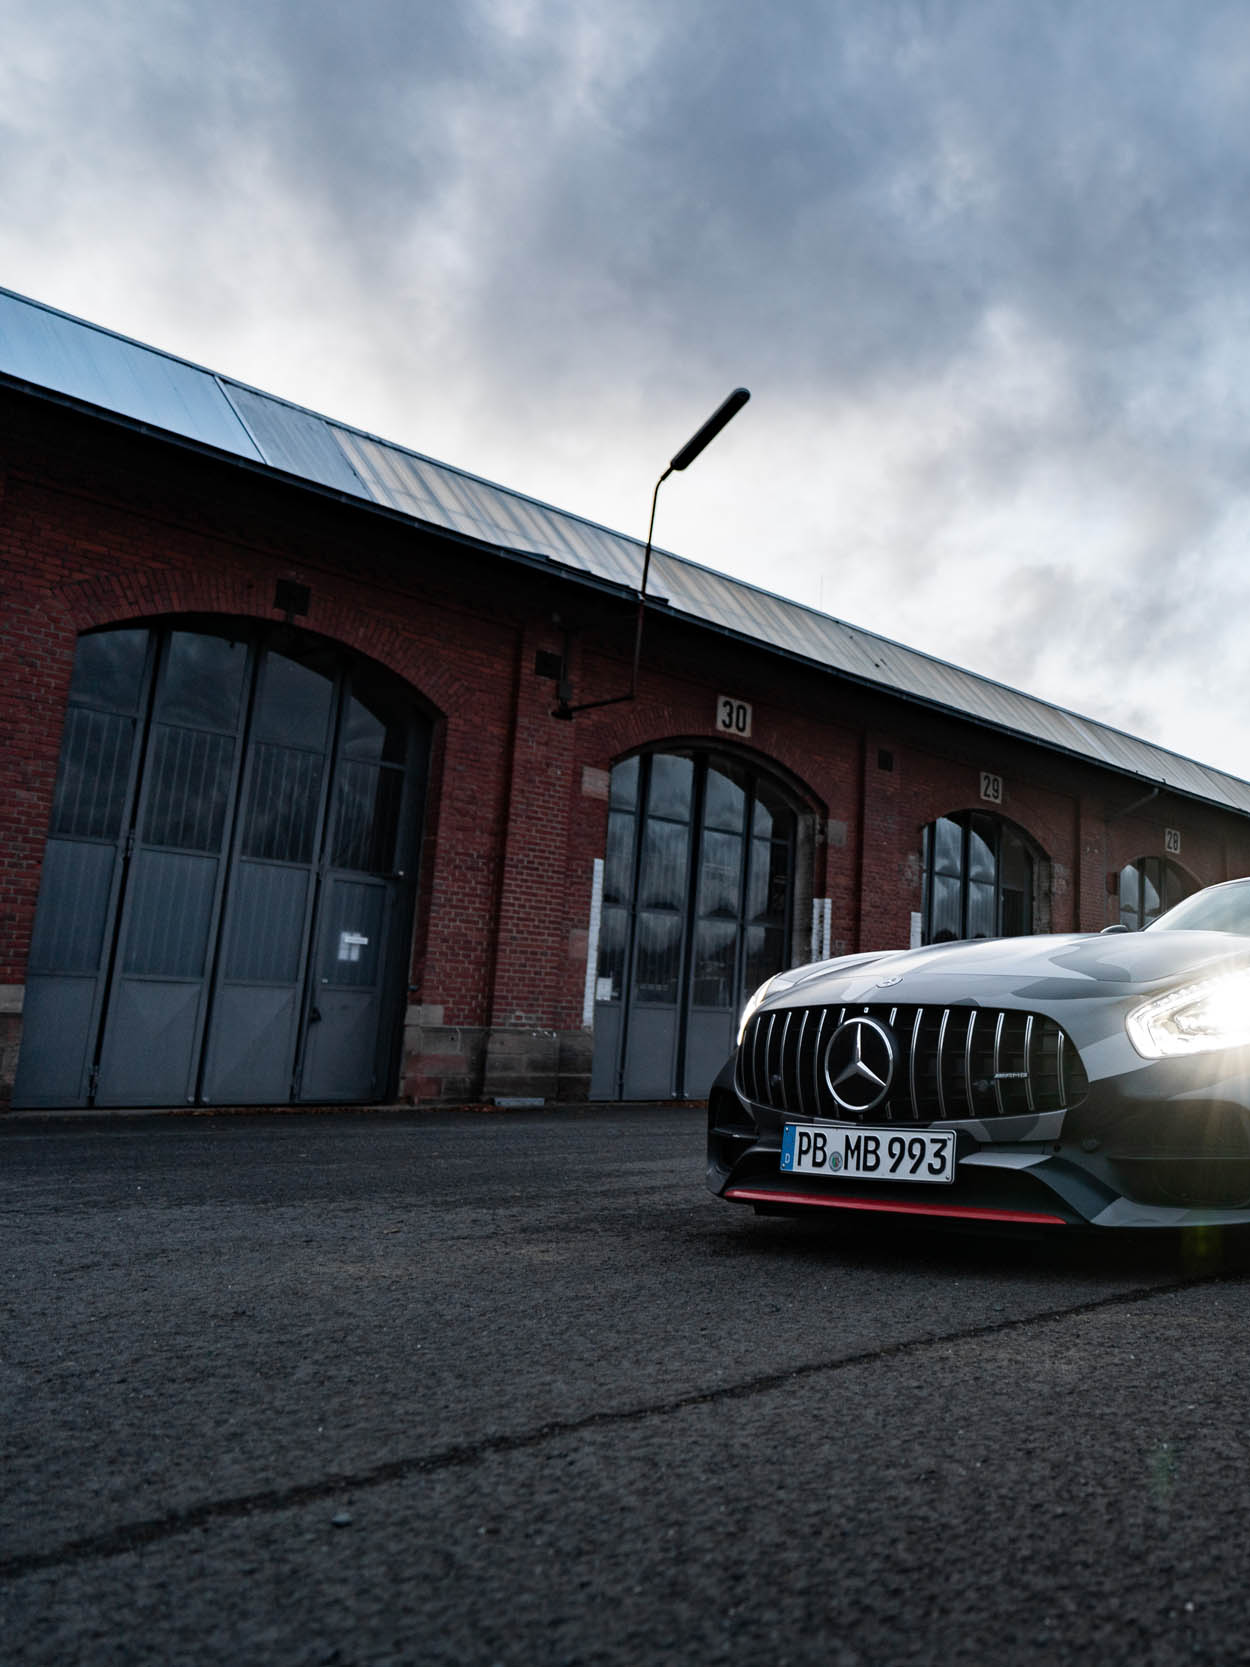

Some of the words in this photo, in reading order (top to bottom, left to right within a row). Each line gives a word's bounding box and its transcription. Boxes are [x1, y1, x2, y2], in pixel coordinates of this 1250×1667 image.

[722, 701, 747, 733] 30
[983, 775, 1000, 800] 29
[784, 1153, 791, 1164] D
[797, 1131, 828, 1168] PB
[843, 1134, 881, 1172] MB
[888, 1136, 949, 1175] 993
